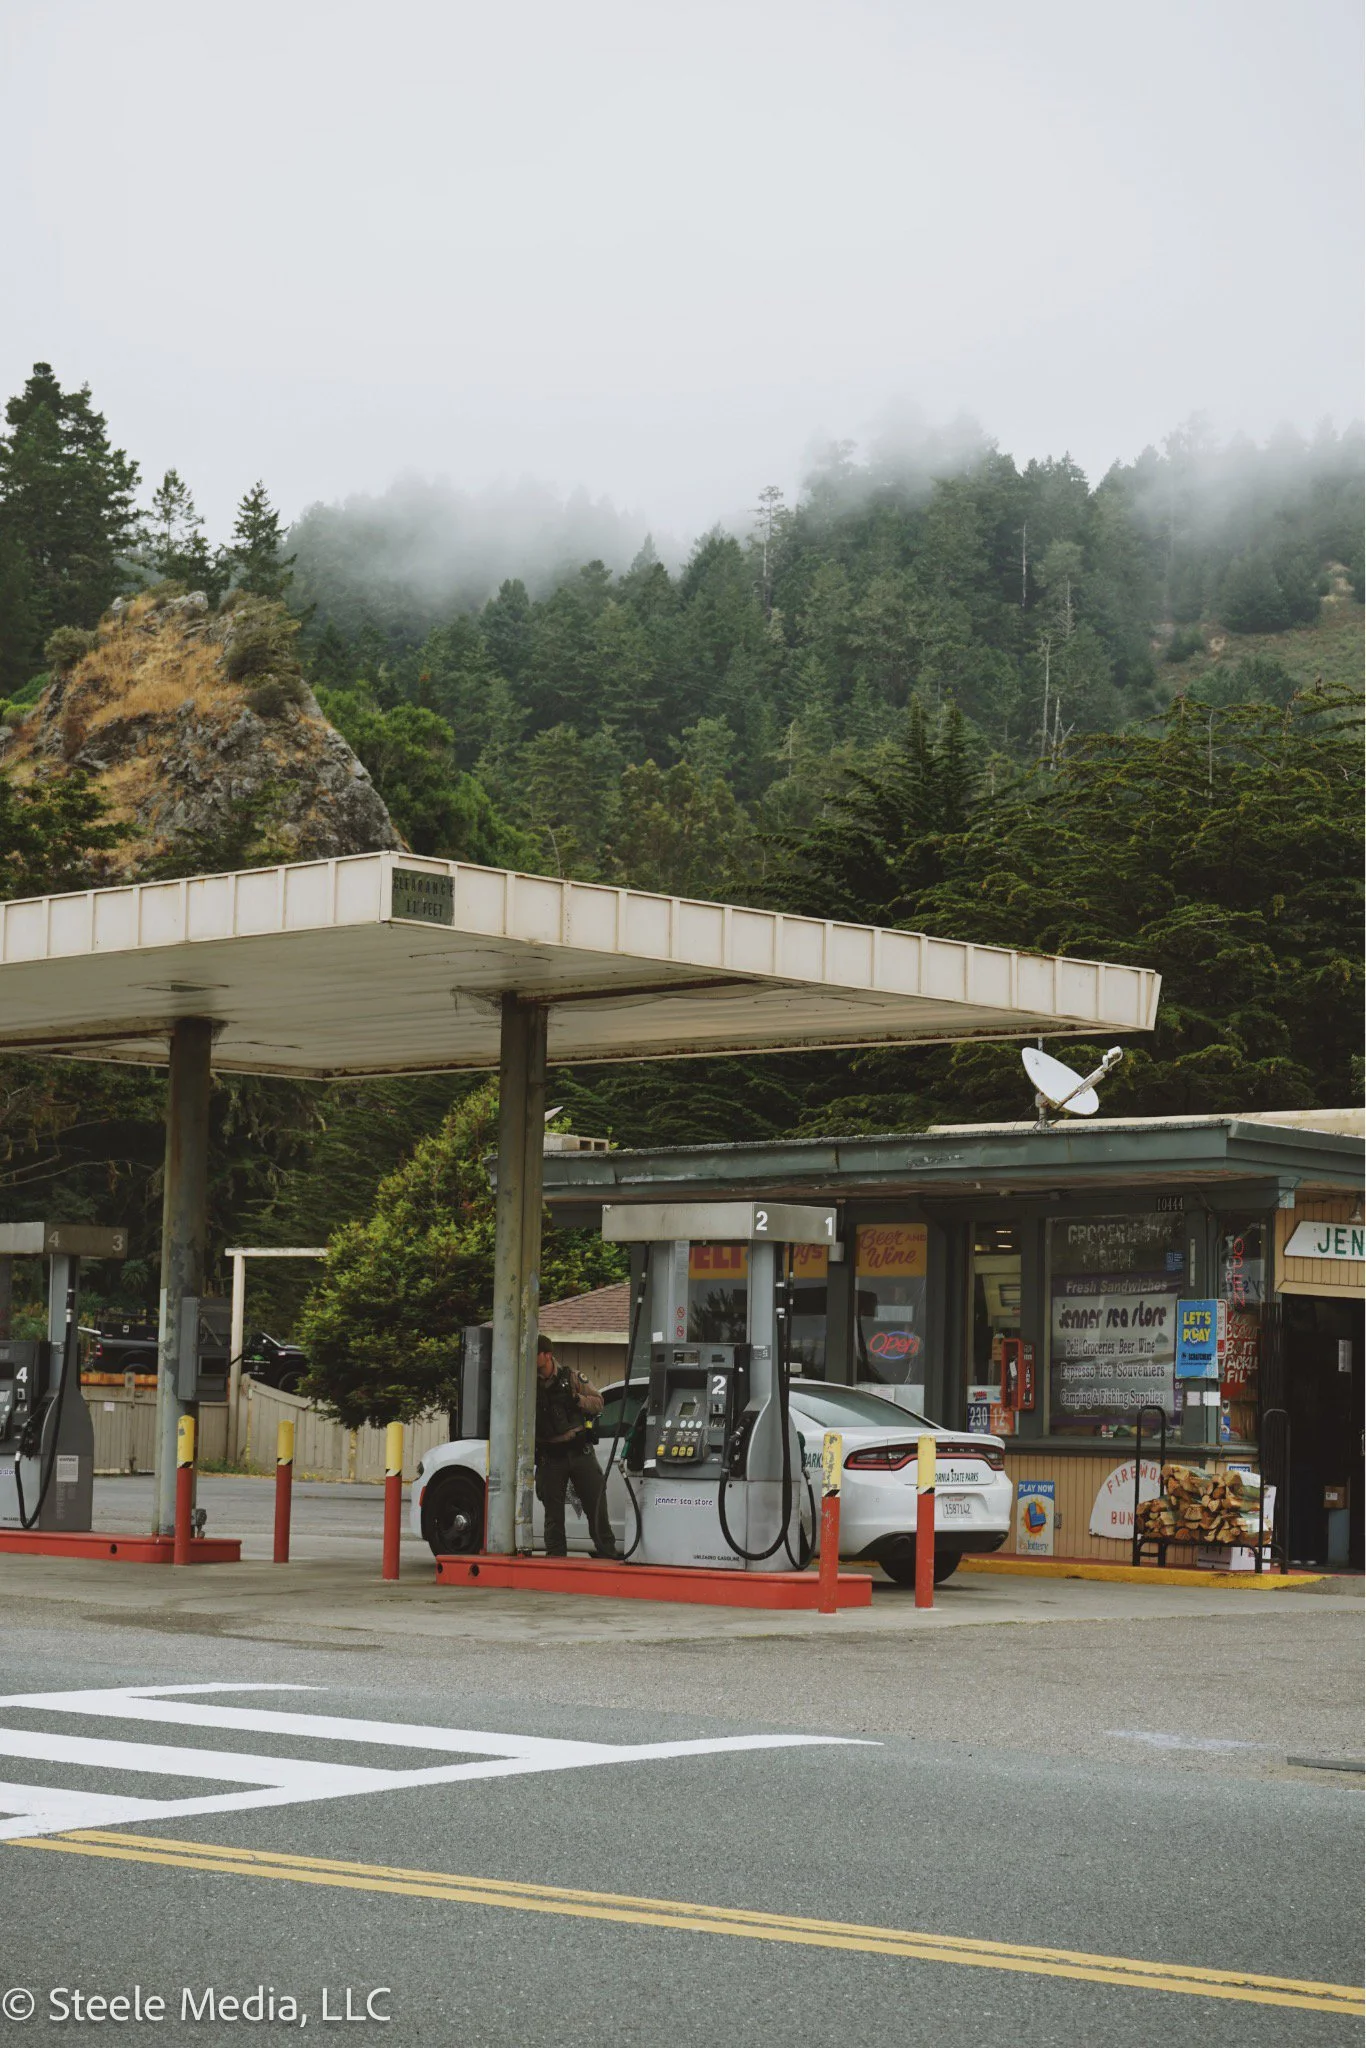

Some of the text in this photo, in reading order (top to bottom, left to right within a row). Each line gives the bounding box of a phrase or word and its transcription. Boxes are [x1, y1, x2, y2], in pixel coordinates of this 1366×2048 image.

[393, 876, 454, 897] CLEARANCE
[423, 902, 443, 917] FEET
[1157, 1197, 1184, 1211] 10444
[756, 1211, 834, 1236] 2 1
[48, 1231, 123, 1251] 4 3
[860, 1228, 926, 1250] Beer AND
[689, 1246, 741, 1269] ELI
[867, 1246, 917, 1268] Wine
[1233, 1237, 1245, 1307] OPEN
[1066, 1279, 1168, 1294] Fresh Sandwiches
[1059, 1301, 1167, 1329] jenner sea store
[1183, 1311, 1212, 1326] LET'S
[869, 1331, 919, 1355] Open
[1066, 1337, 1155, 1356] Deli Groceries Beer Wine
[16, 1366, 28, 1383] 4
[1061, 1361, 1165, 1381] Espresso Ice Souveniers
[1226, 1370, 1252, 1384] FIL
[711, 1375, 726, 1394] 2
[1061, 1389, 1092, 1409] Camping
[1100, 1389, 1129, 1409] Fishing
[1130, 1387, 1165, 1408] Supplies
[969, 1406, 989, 1426] 230
[950, 1472, 964, 1483] STATE
[965, 1472, 980, 1482] PARKS
[1107, 1464, 1161, 1495] FIREWO
[1018, 1484, 1054, 1492] PLAY NOW
[655, 1497, 677, 1506] jenner
